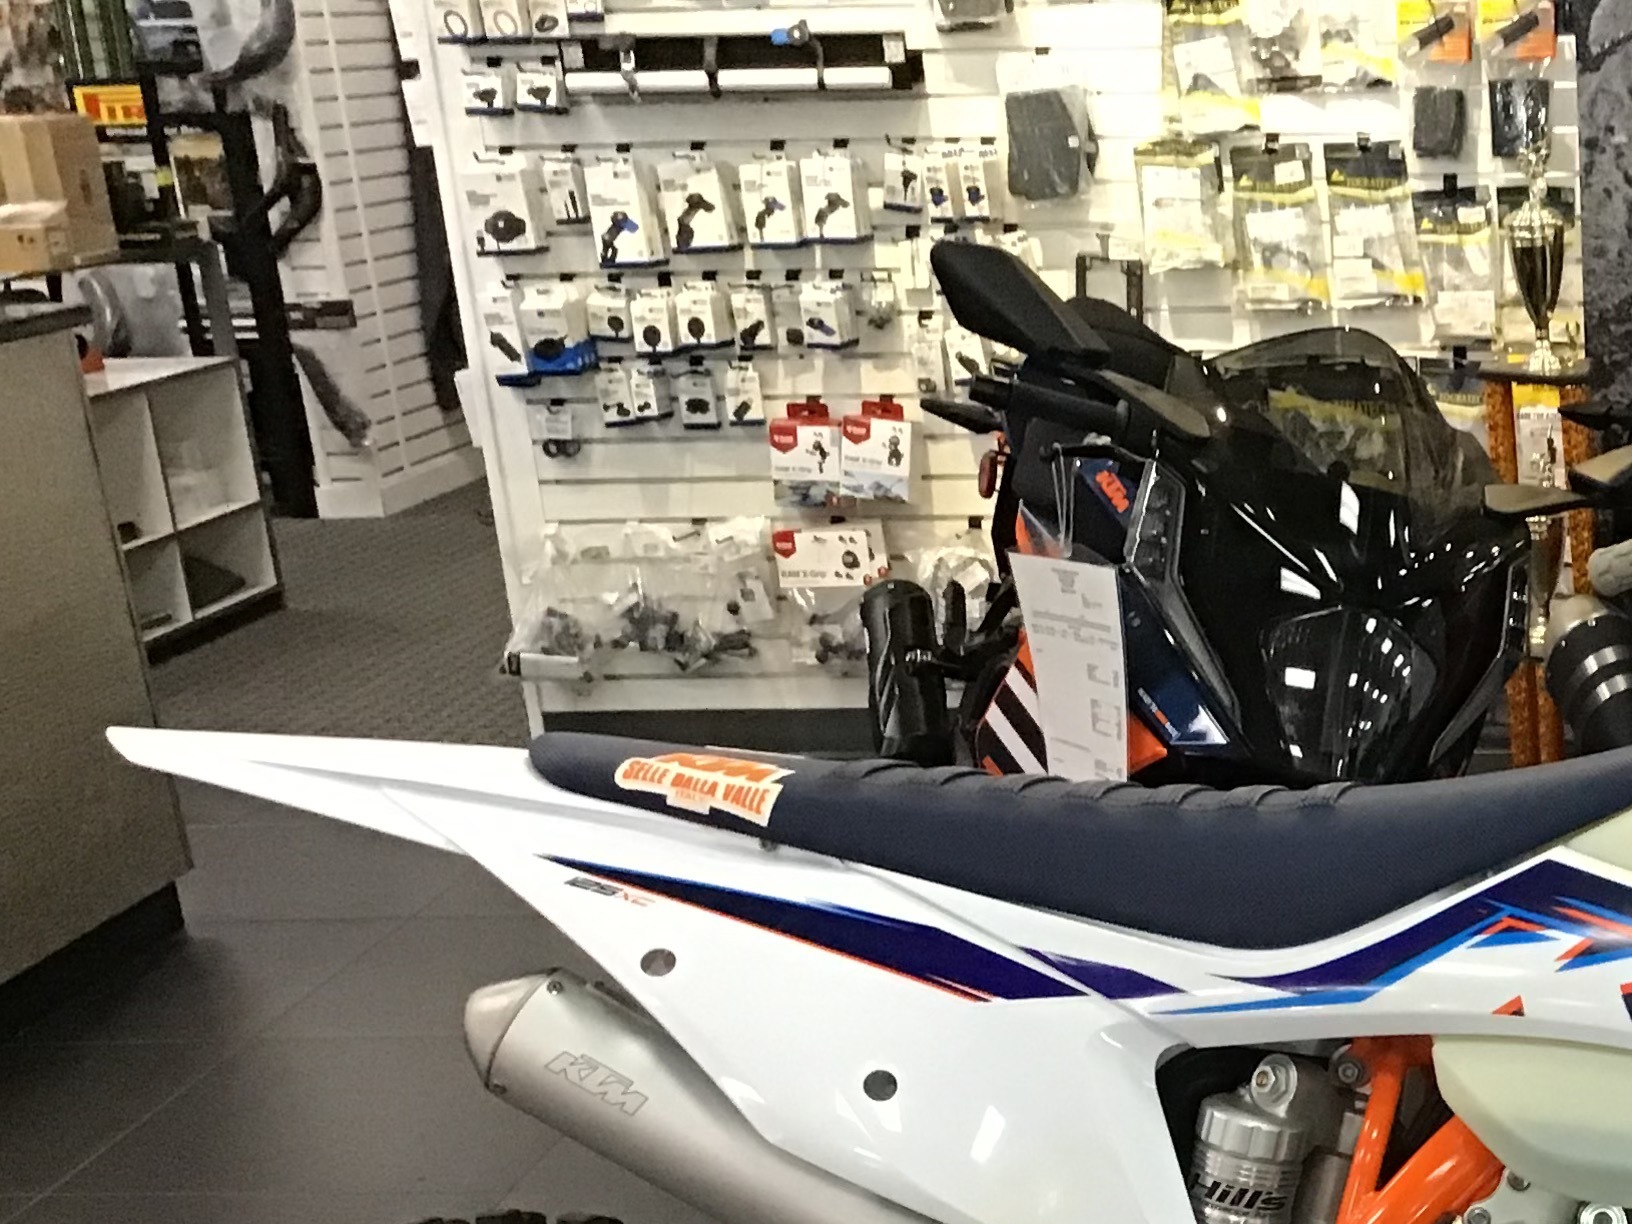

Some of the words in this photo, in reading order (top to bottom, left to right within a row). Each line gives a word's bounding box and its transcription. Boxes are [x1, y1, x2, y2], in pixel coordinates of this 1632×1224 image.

[1095, 470, 1130, 514] KTM
[622, 760, 672, 785] SELLE
[722, 783, 771, 816] VALLE
[544, 1051, 650, 1117] KTM
